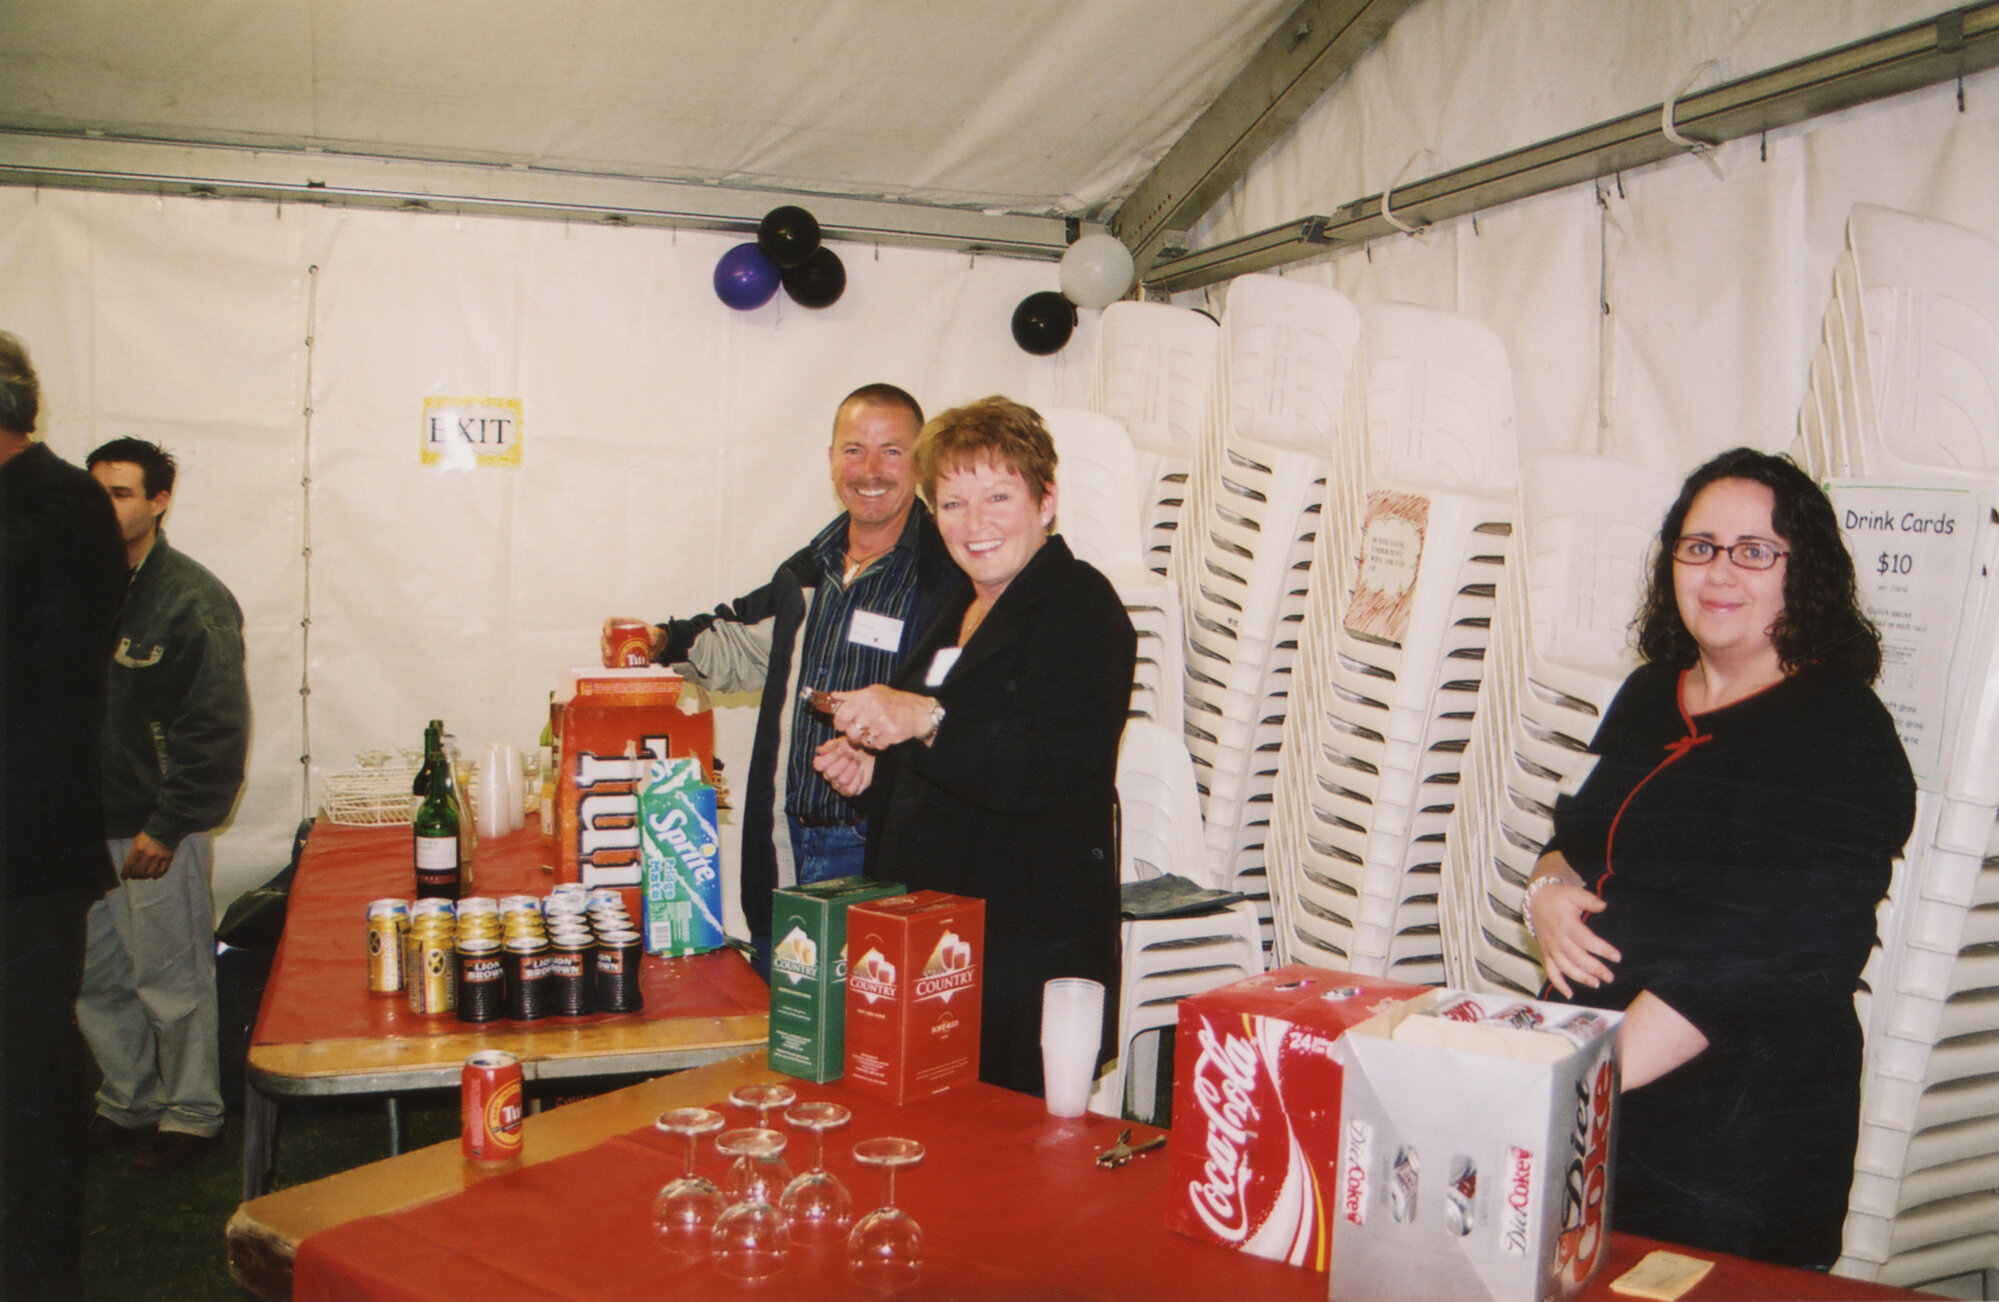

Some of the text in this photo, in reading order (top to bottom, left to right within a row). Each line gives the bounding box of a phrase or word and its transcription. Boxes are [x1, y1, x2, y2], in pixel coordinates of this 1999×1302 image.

[430, 417, 511, 444] EXIT
[1845, 509, 1955, 535] Drink Cards
[1876, 552, 1912, 576] $10
[649, 808, 716, 882] Sprite
[649, 859, 662, 900] Mate
[664, 857, 676, 900] Fridge
[475, 961, 500, 972] LION
[525, 965, 551, 978] BRO
[533, 957, 550, 969] LIO
[550, 964, 580, 974] ROWN
[552, 957, 572, 966] ION
[598, 961, 620, 971] OWN
[774, 959, 818, 978] COUNTRY
[467, 967, 503, 979] BROW
[915, 969, 975, 997] COUNTRY
[850, 978, 897, 998] COUNTRY
[1289, 1031, 1311, 1052] 24
[503, 1103, 522, 1124] Tu
[1189, 1012, 1261, 1242] Coca-Cola
[1346, 1117, 1367, 1211] Diet Coke
[1560, 1057, 1612, 1283] Diet Coke
[1504, 1160, 1531, 1258] Diet Coke
